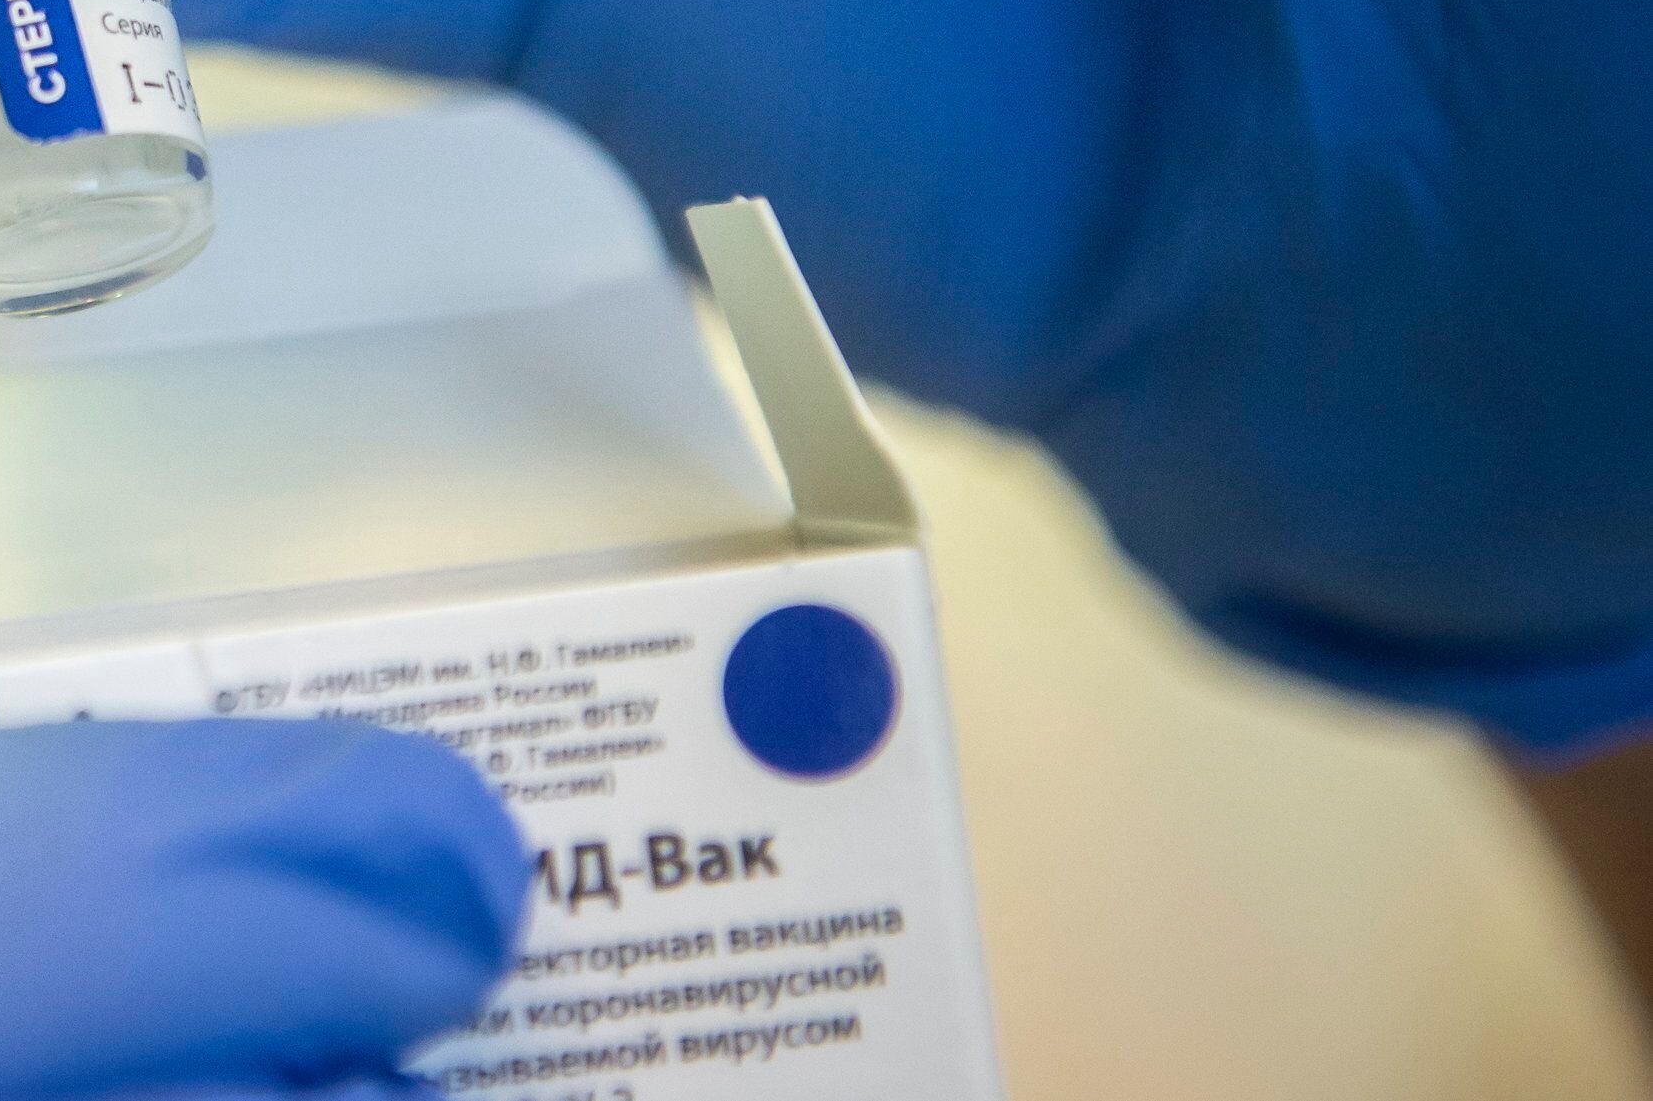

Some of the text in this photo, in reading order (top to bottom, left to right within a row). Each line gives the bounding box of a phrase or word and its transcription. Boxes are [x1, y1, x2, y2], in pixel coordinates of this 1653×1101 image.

[102, 11, 164, 41] Серия
[493, 678, 597, 709] России
[582, 697, 660, 728] ФГБУ
[728, 903, 905, 954] вакцина
[525, 950, 888, 1037] коронавирусной
[679, 1012, 863, 1064] вирусом
